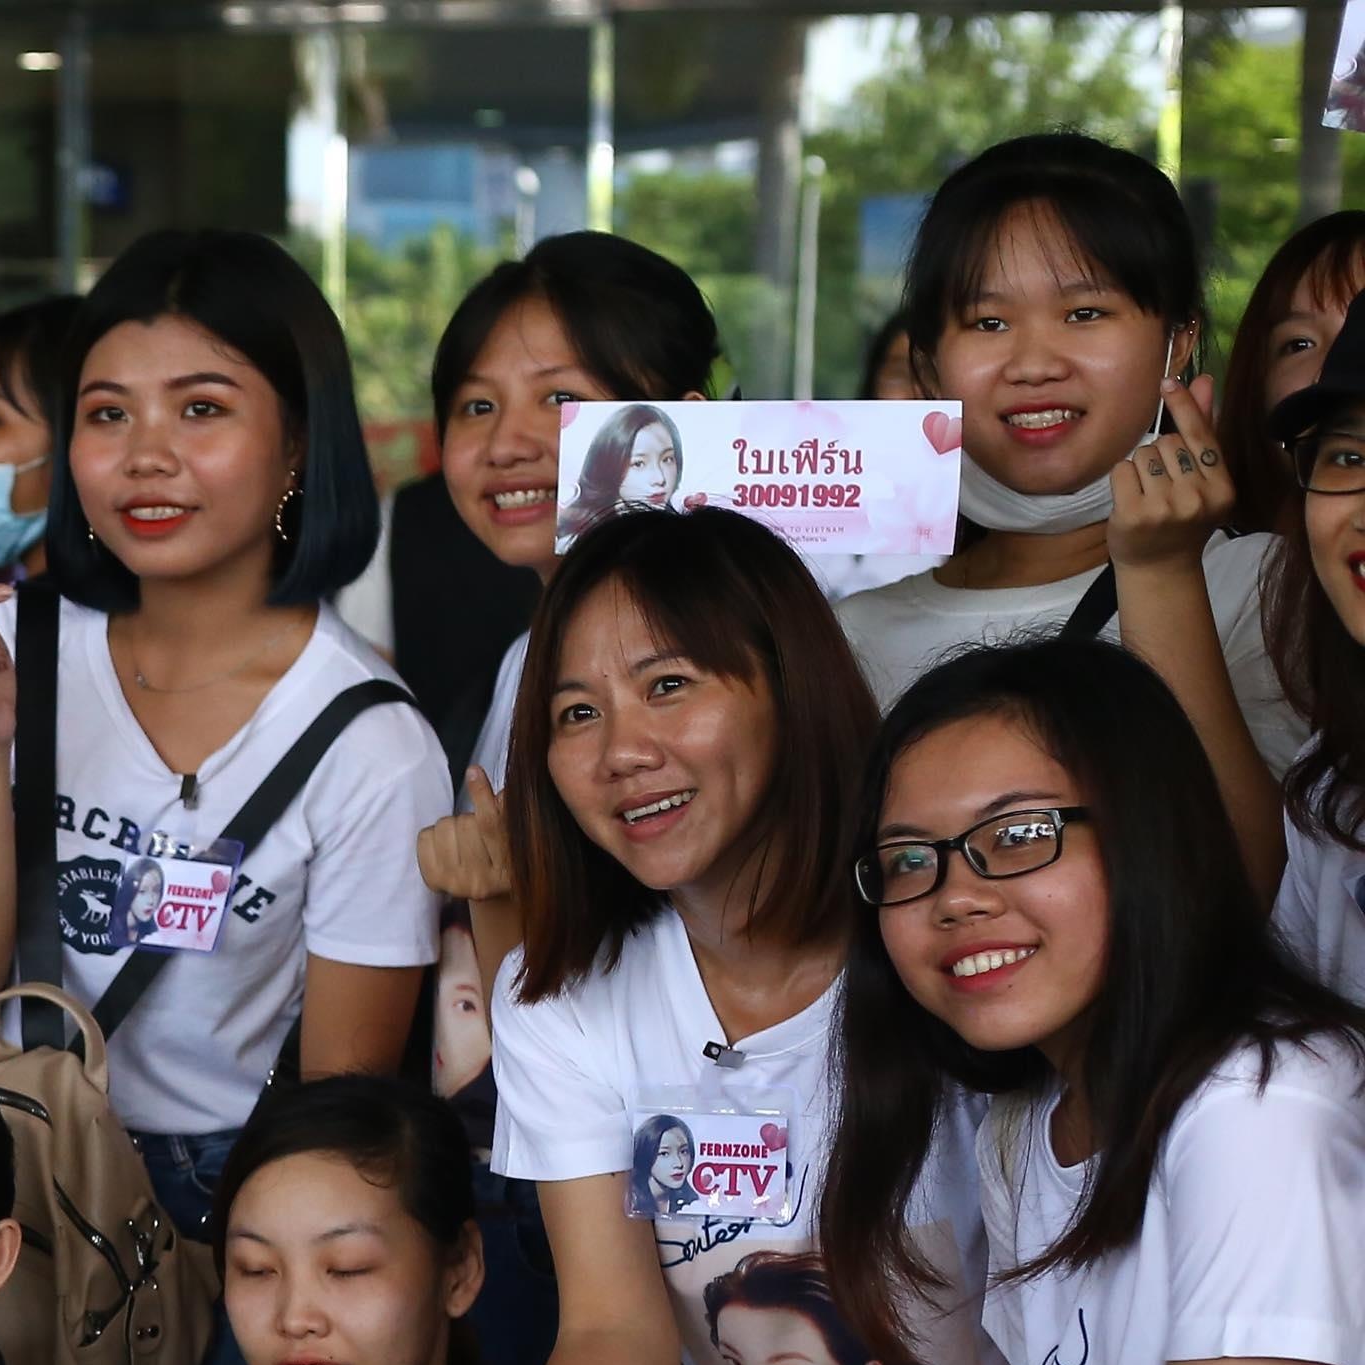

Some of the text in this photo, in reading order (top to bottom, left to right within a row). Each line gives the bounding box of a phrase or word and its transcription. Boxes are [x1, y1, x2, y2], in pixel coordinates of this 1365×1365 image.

[732, 483, 862, 508] 30091992
[156, 901, 217, 933] CTV
[81, 931, 112, 946] YOR
[699, 1142, 769, 1159] FERNZONE
[691, 1162, 779, 1198] CTV
